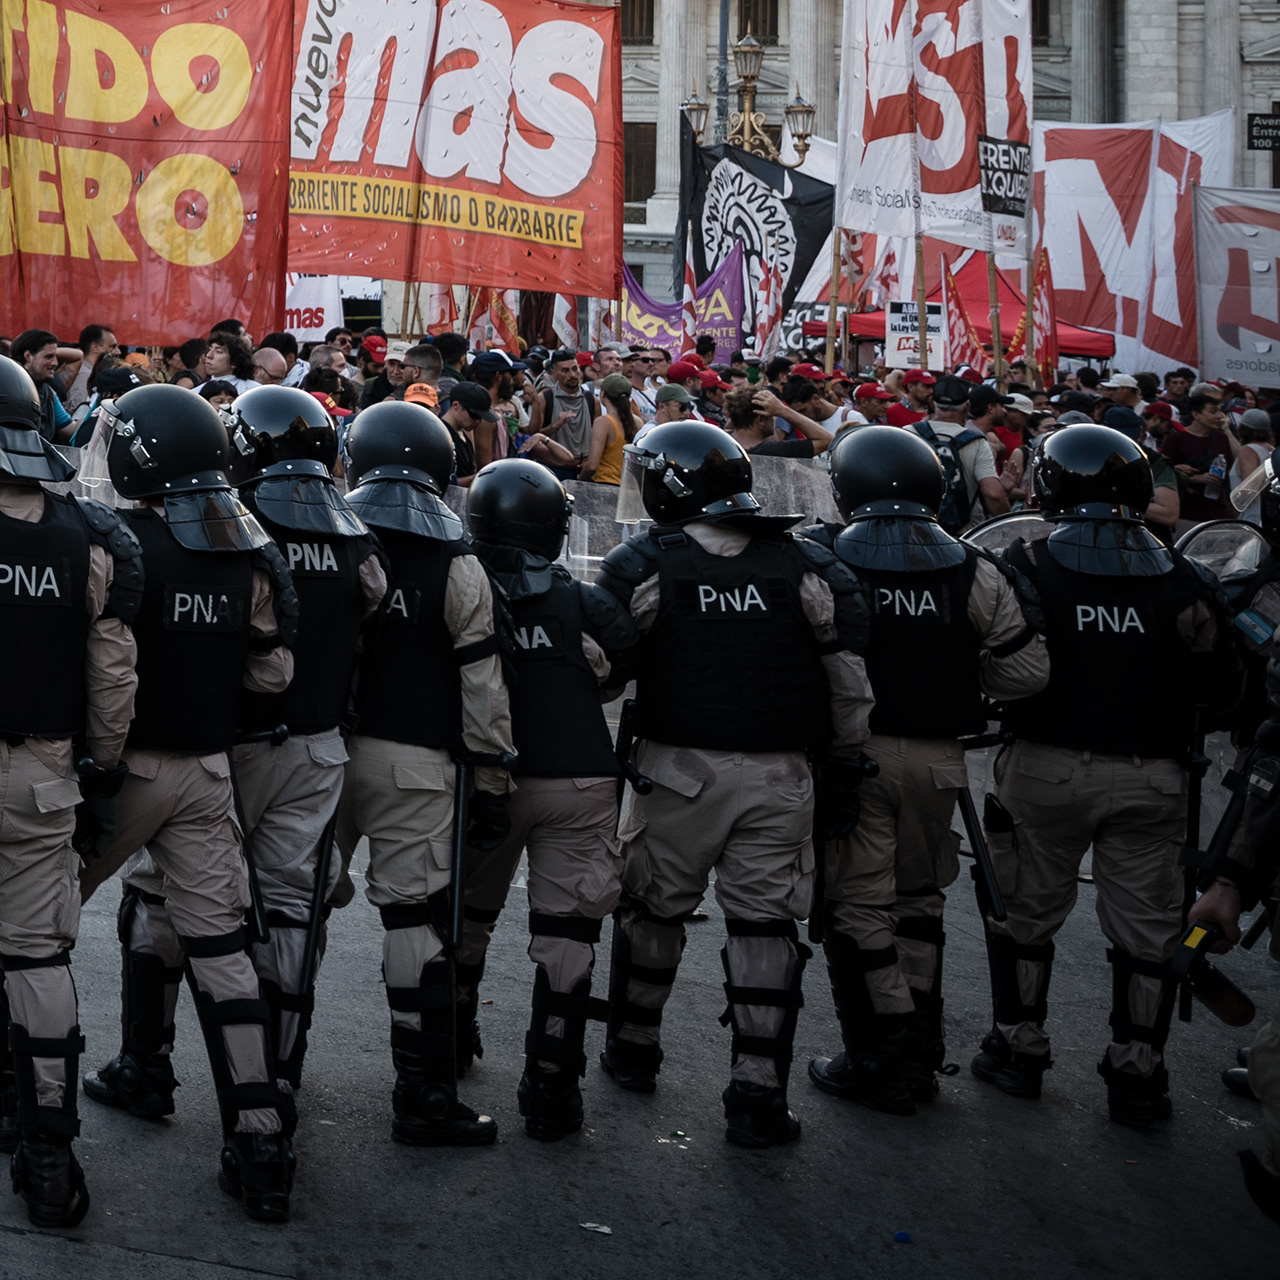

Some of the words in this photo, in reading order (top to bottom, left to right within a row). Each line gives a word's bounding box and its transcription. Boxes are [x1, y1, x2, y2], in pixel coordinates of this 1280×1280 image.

[1252, 139, 1273, 148] 100
[289, 178, 358, 213] ORRIENTE
[362, 182, 461, 224] SOCIALISMO
[467, 196, 479, 227] O
[484, 200, 579, 244] BARBARIE
[285, 306, 325, 330] mas
[898, 324, 909, 333] Ley
[287, 542, 339, 573] PNA
[698, 582, 767, 613] PNA
[879, 588, 936, 615] PNA
[1076, 604, 1145, 634] PNA
[510, 625, 552, 650] NA
